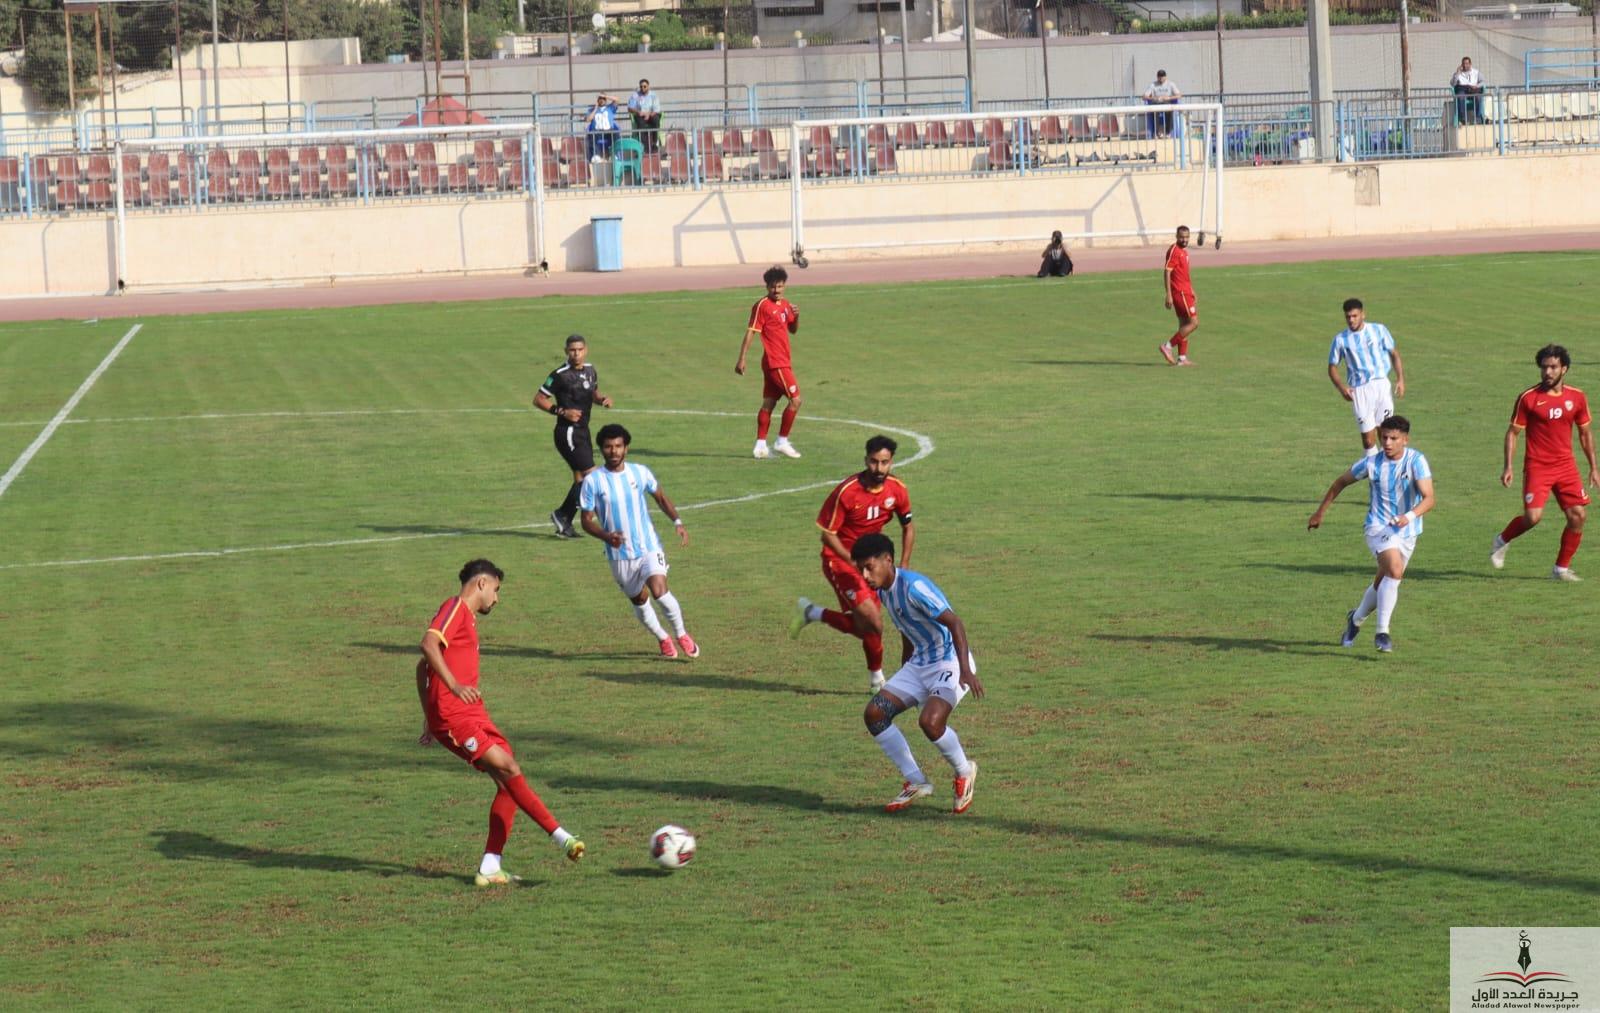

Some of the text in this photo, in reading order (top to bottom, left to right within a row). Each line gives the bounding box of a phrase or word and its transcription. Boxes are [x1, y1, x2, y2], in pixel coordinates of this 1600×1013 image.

[1549, 408, 1563, 419] 19
[866, 505, 880, 520] 11
[938, 670, 953, 682] 17
